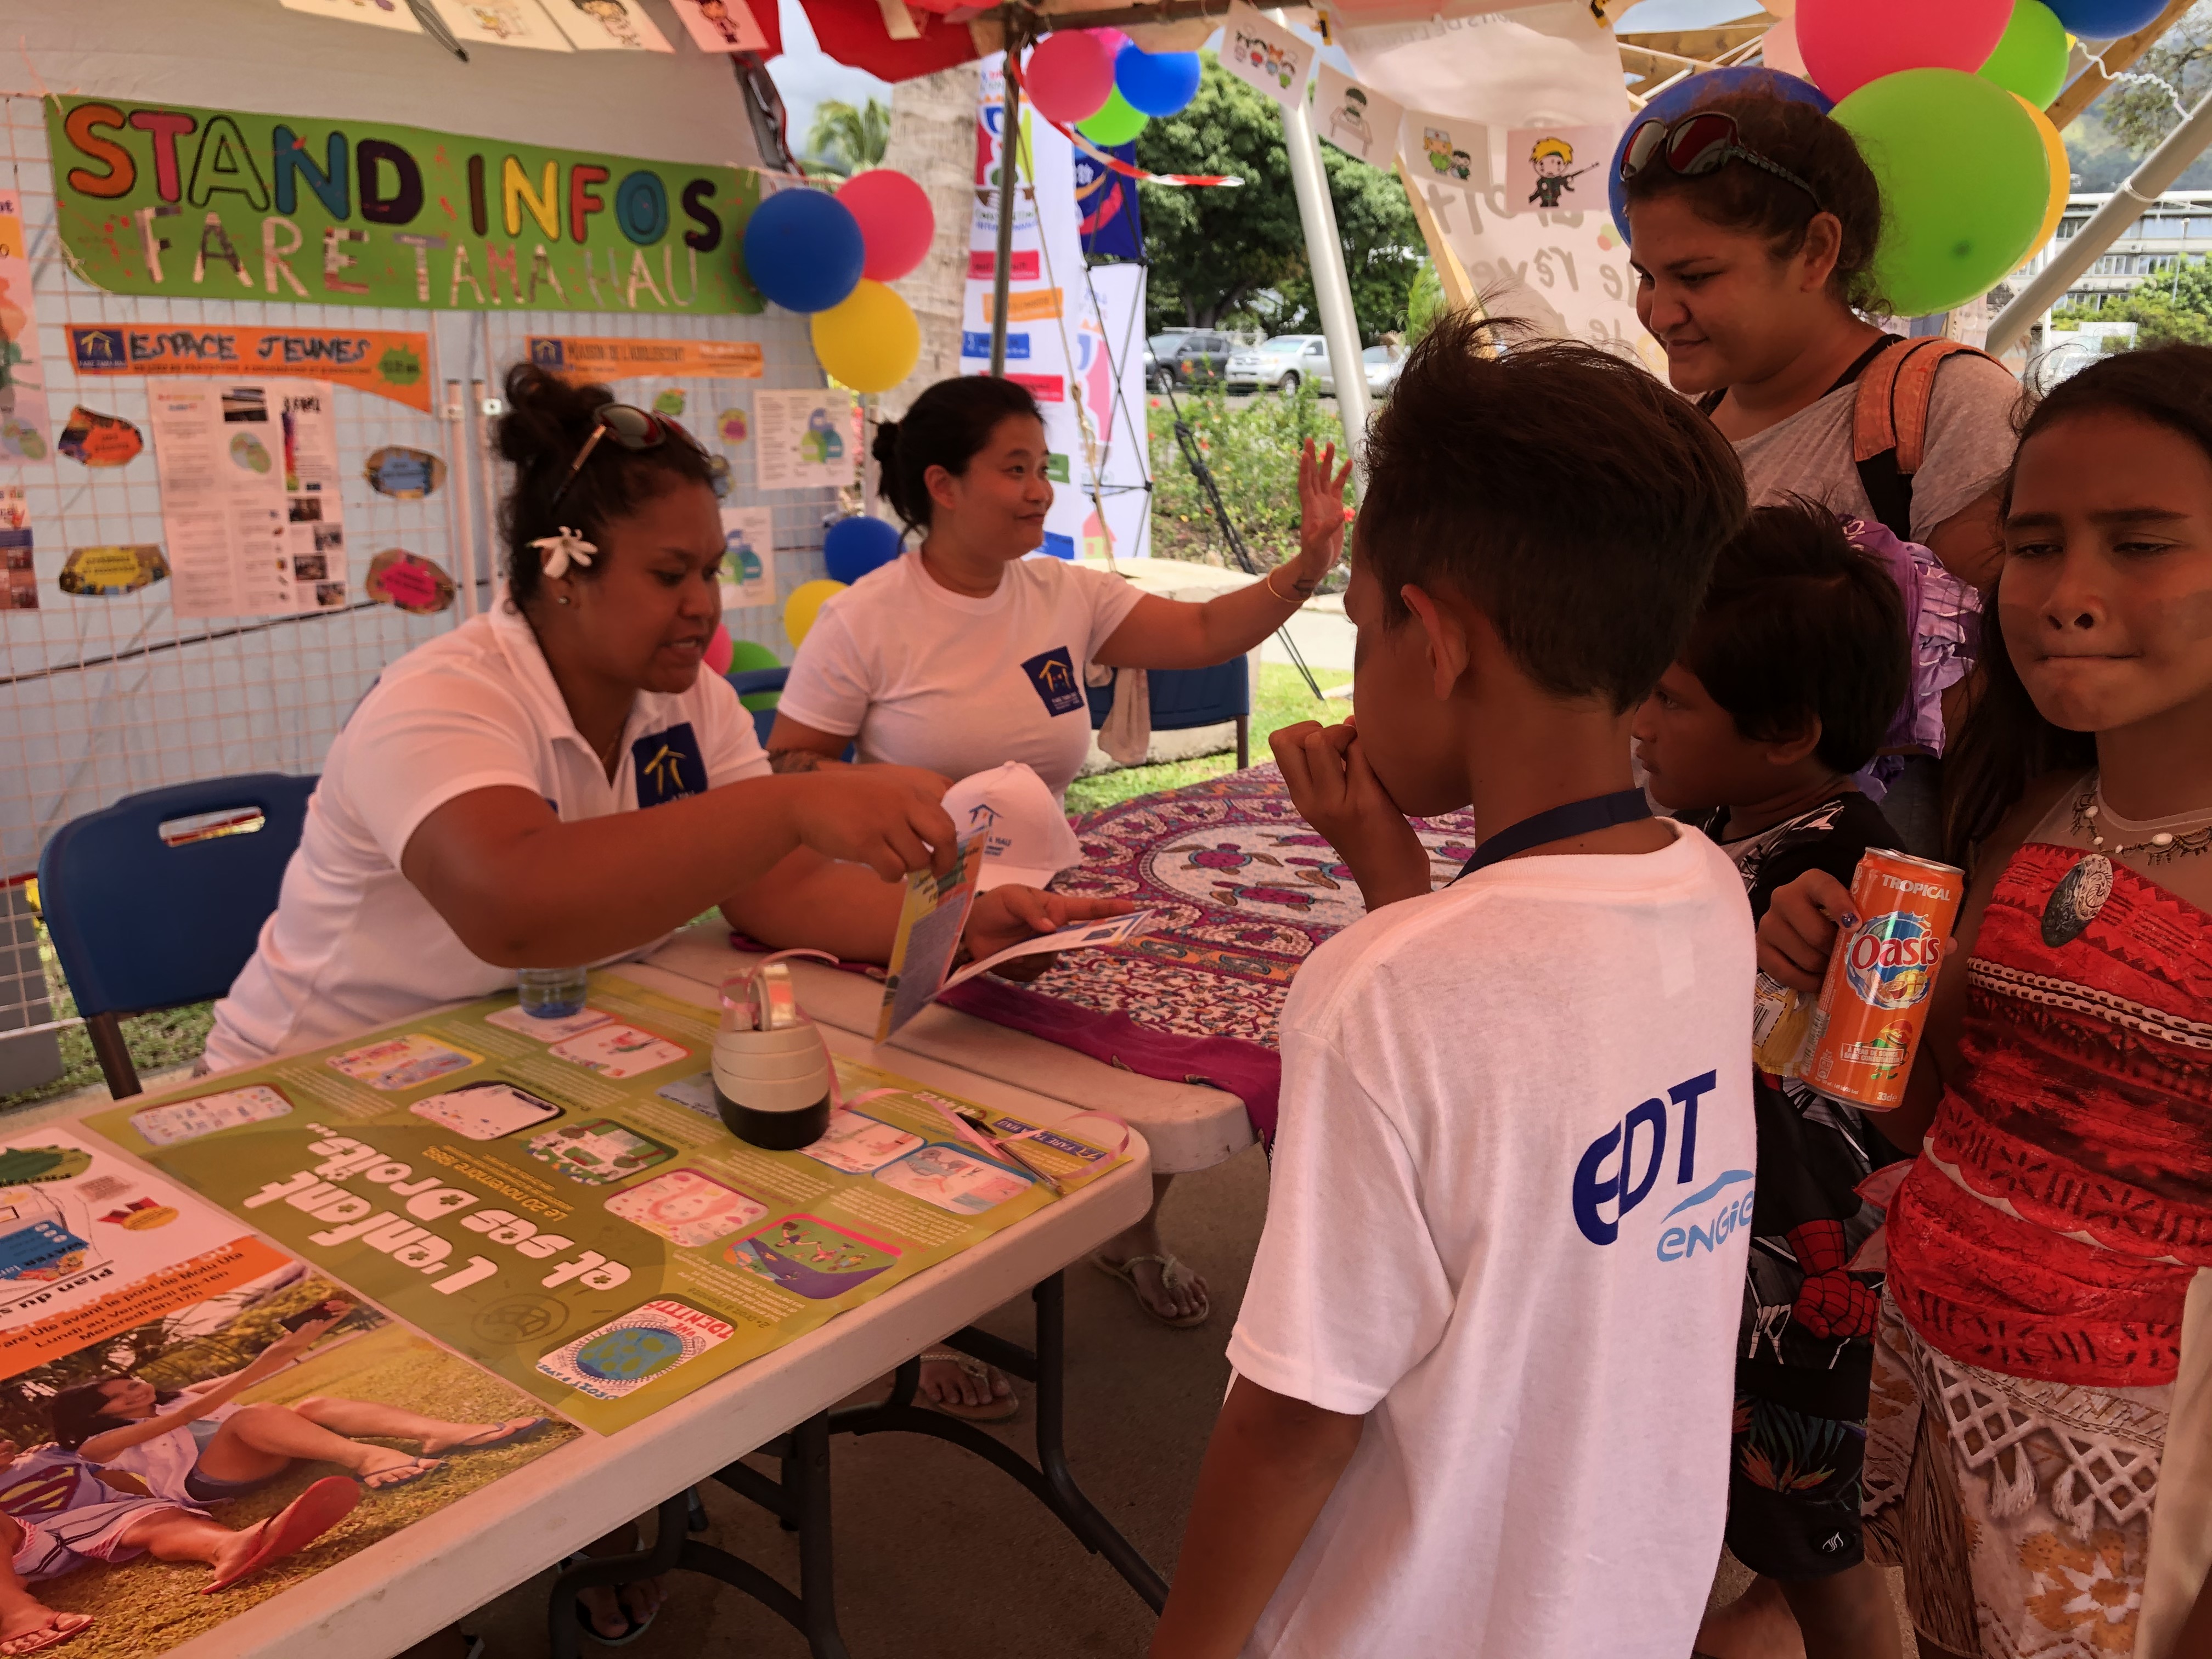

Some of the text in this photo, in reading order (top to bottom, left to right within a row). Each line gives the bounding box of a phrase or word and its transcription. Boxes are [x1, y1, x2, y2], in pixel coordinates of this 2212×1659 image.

[64, 102, 723, 253] STAND INFOS
[134, 203, 698, 308] FARE TAMA HAU
[129, 330, 371, 364] ESPACE JEUNES
[1882, 873, 1950, 901] TROPICAL
[1850, 928, 1941, 970] Oasis
[1020, 1128, 1047, 1142] TAA
[1572, 1069, 1717, 1245] EDT
[452, 1162, 528, 1202] novembre
[522, 1198, 549, 1212] 20
[543, 1208, 569, 1222] Le
[242, 1169, 499, 1296] L'enfant
[459, 1207, 577, 1261] ses
[18, 1267, 115, 1309] Plan du
[541, 1249, 632, 1292] et
[0, 1335, 29, 1348] are
[61, 1305, 105, 1326] avant
[104, 1298, 121, 1307] le
[122, 1283, 159, 1302] pont
[159, 1277, 179, 1287] de
[179, 1263, 218, 1280] Motu
[217, 1252, 244, 1265] Uta
[35, 1327, 83, 1348] Lundi
[86, 1318, 106, 1329] au
[106, 1289, 177, 1318] Vendredi
[78, 1309, 149, 1340] Mercredi
[670, 1322, 697, 1338] UNE
